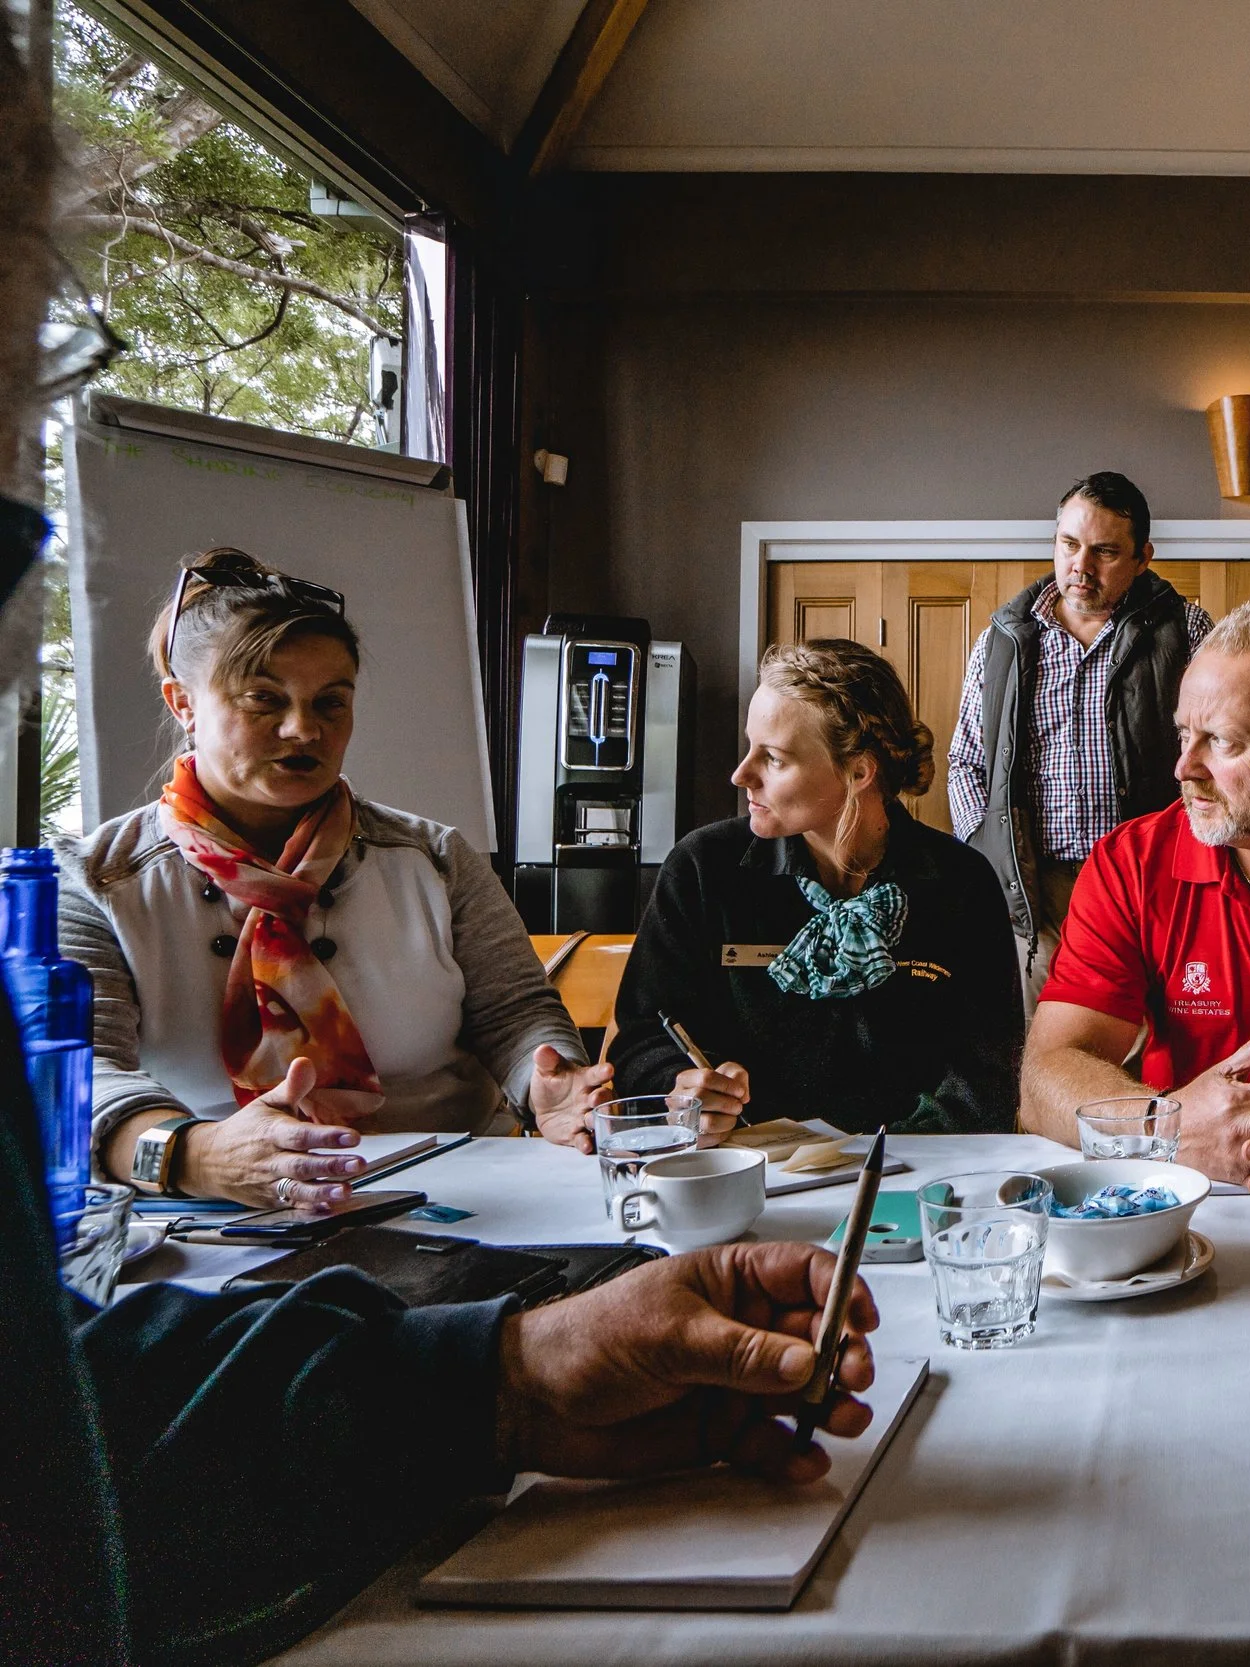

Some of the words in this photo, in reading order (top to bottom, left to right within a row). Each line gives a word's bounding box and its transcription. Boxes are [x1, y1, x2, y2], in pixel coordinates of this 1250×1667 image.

[911, 960, 928, 968] Coast
[911, 969, 938, 981] Railway
[1191, 1008, 1231, 1016] ESTATES
